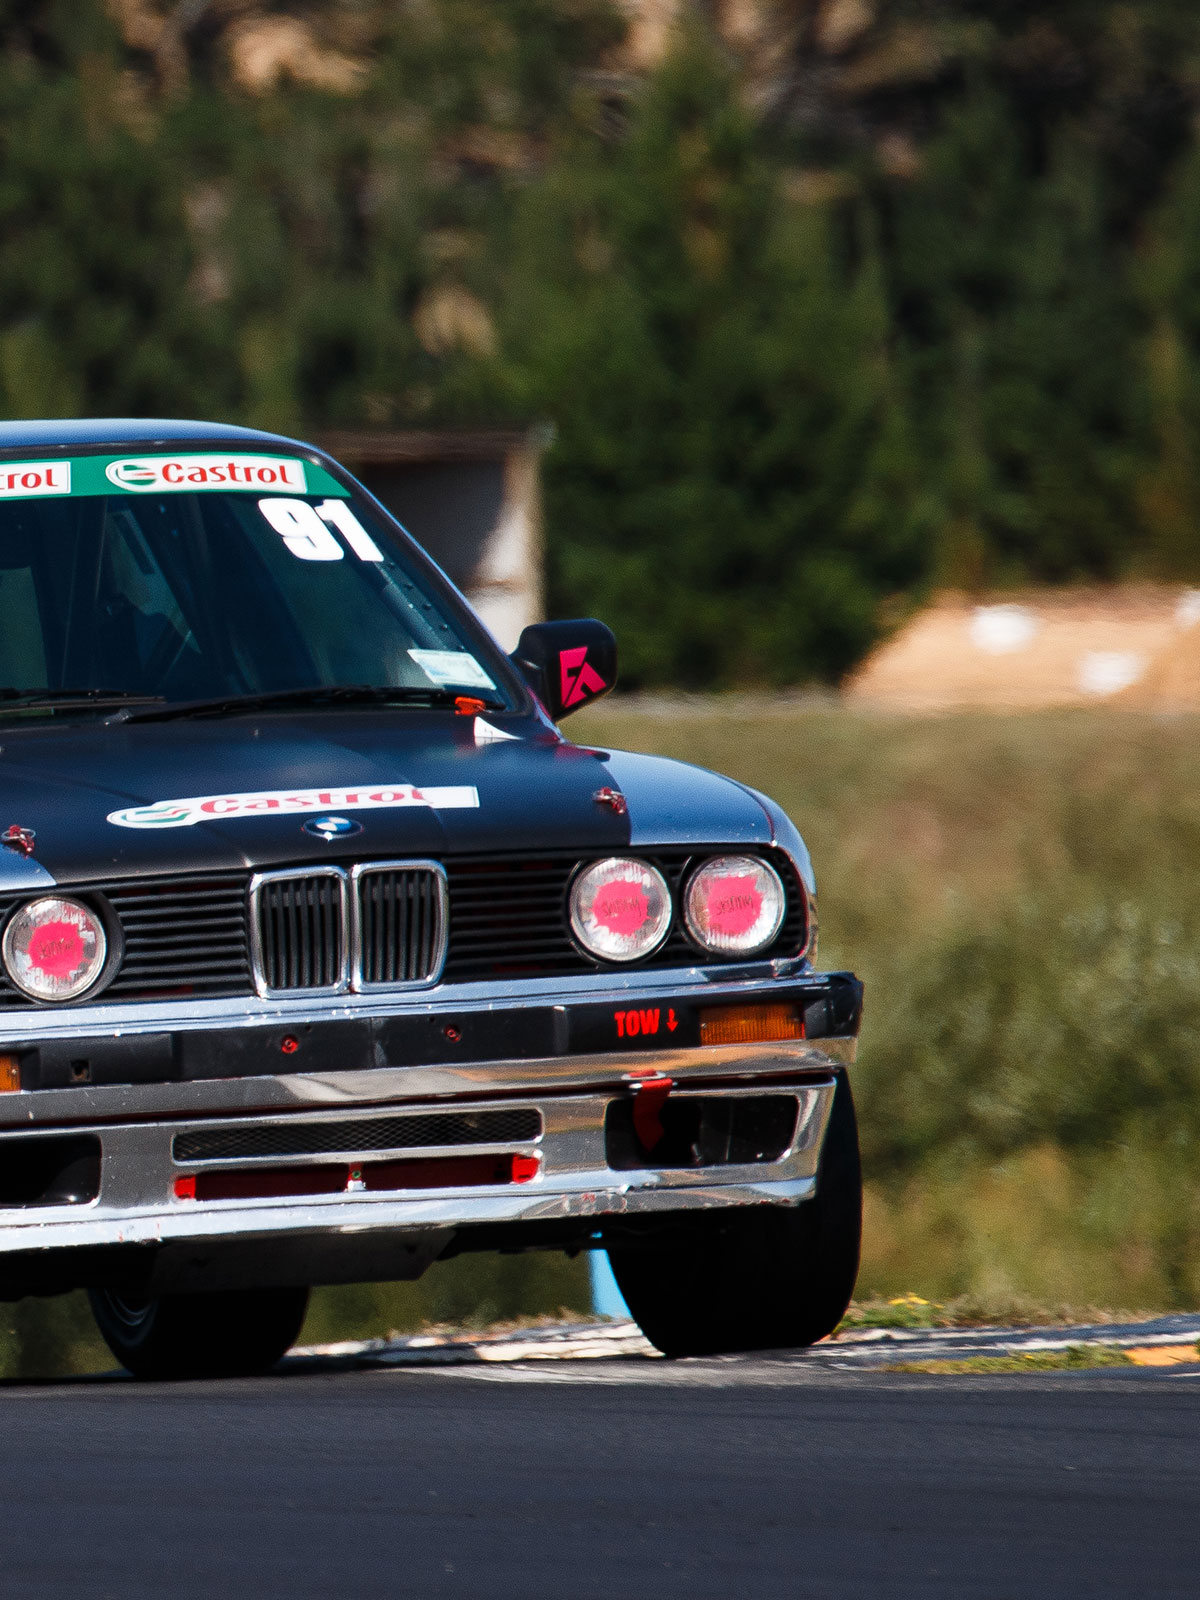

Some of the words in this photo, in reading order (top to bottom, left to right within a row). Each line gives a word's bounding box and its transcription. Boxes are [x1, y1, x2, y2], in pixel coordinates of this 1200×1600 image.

[161, 461, 295, 486] Castrol
[257, 498, 384, 562] 91
[200, 788, 433, 815] Castrol
[613, 1008, 661, 1038] TOW
